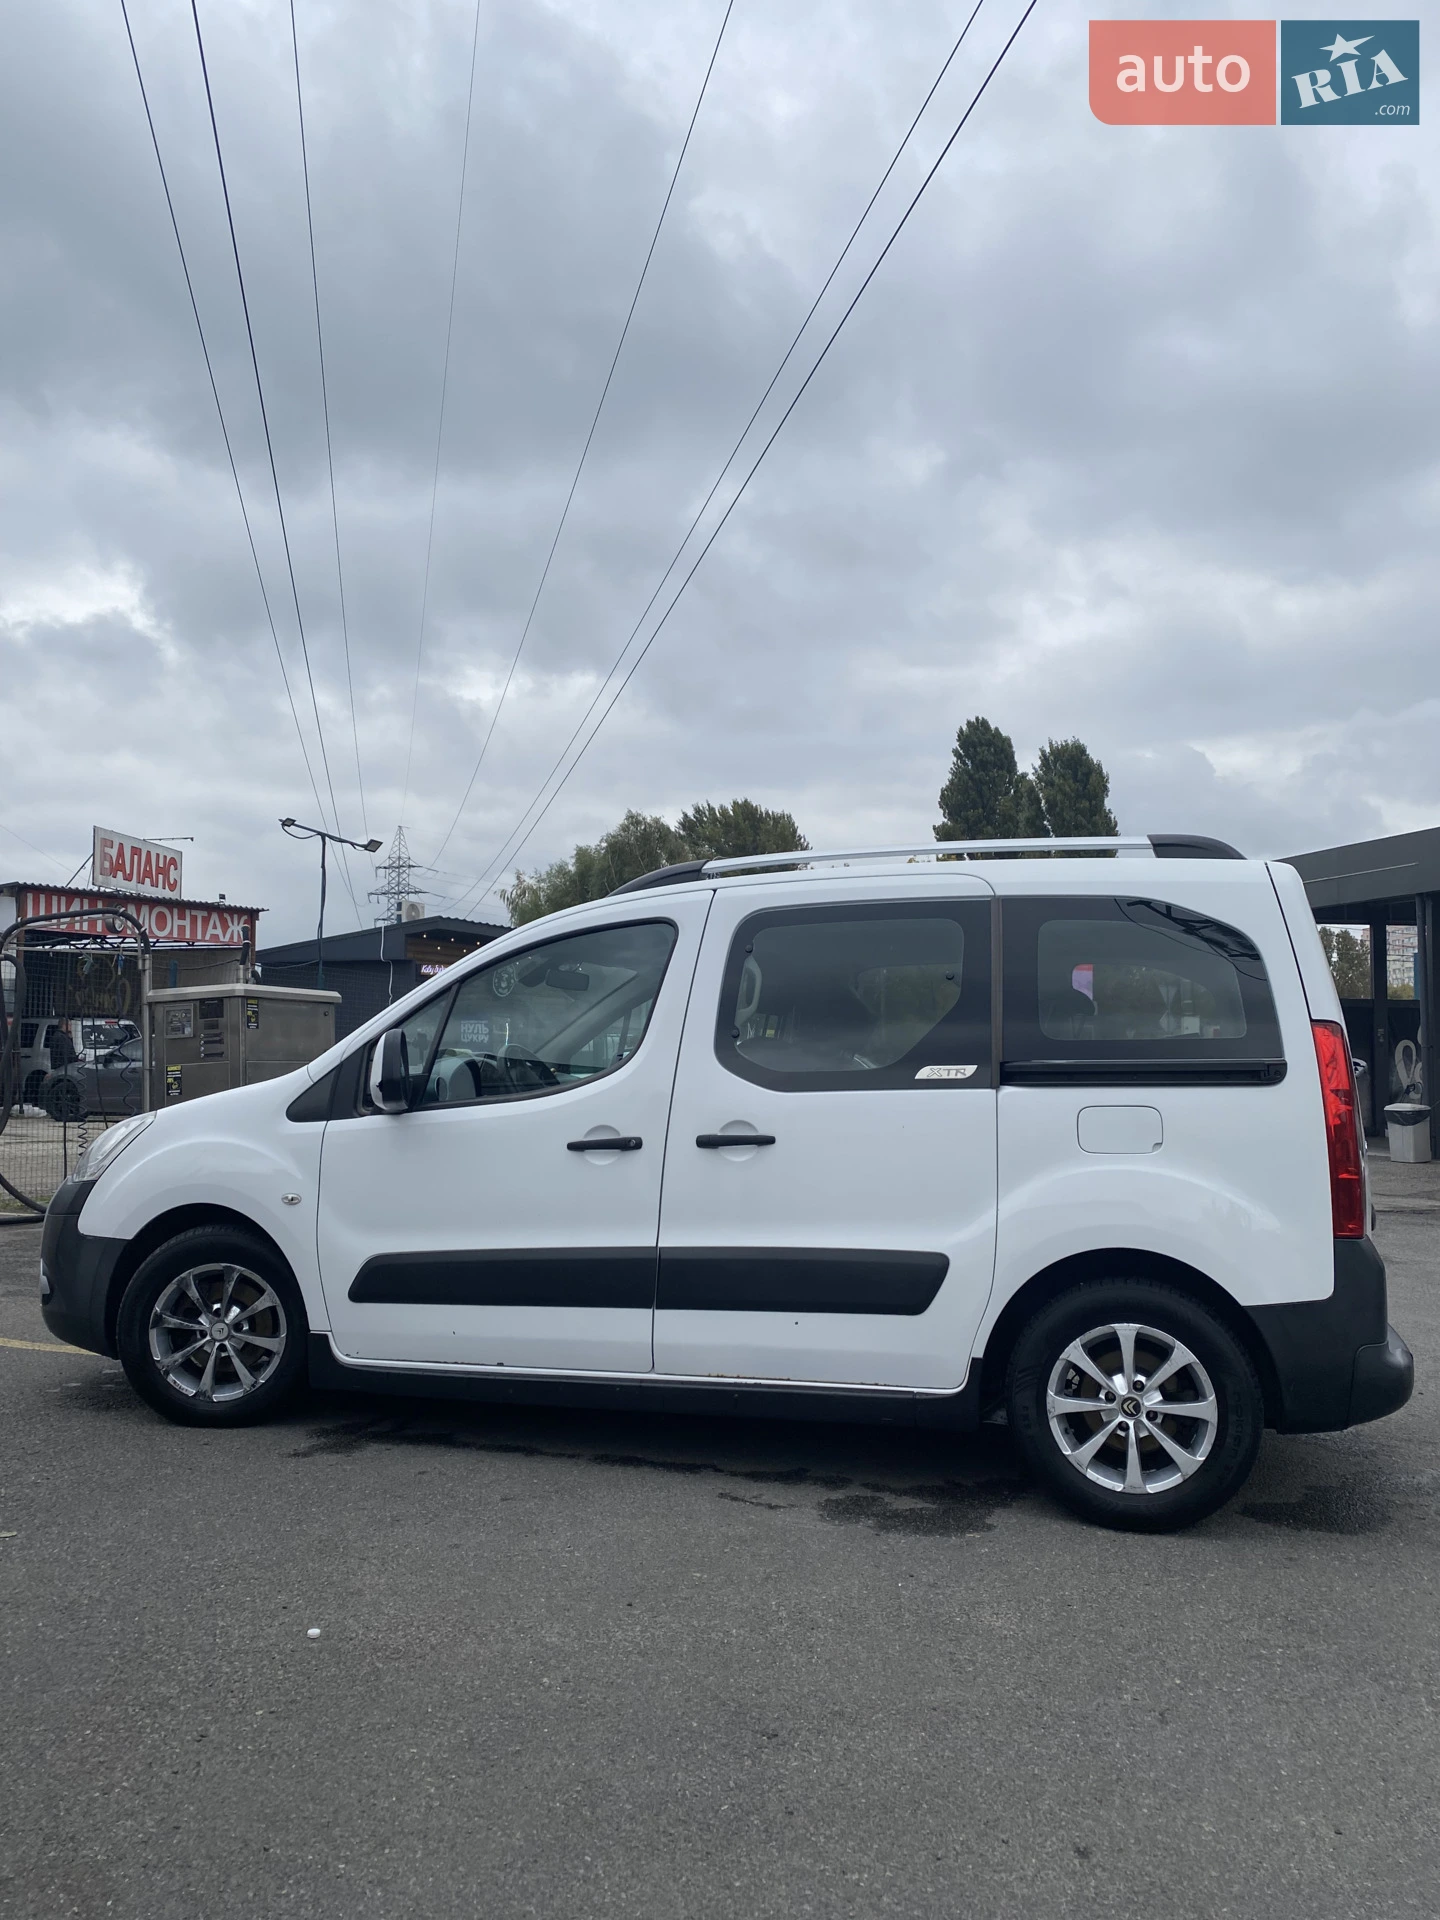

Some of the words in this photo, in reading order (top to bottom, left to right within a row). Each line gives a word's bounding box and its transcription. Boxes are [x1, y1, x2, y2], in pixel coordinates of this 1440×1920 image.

[100, 837, 178, 892] БАЛАНС
[461, 1023, 489, 1034] НУЛЬ
[461, 1033, 489, 1043] ЦУКРУ
[927, 1067, 967, 1078] XTR
